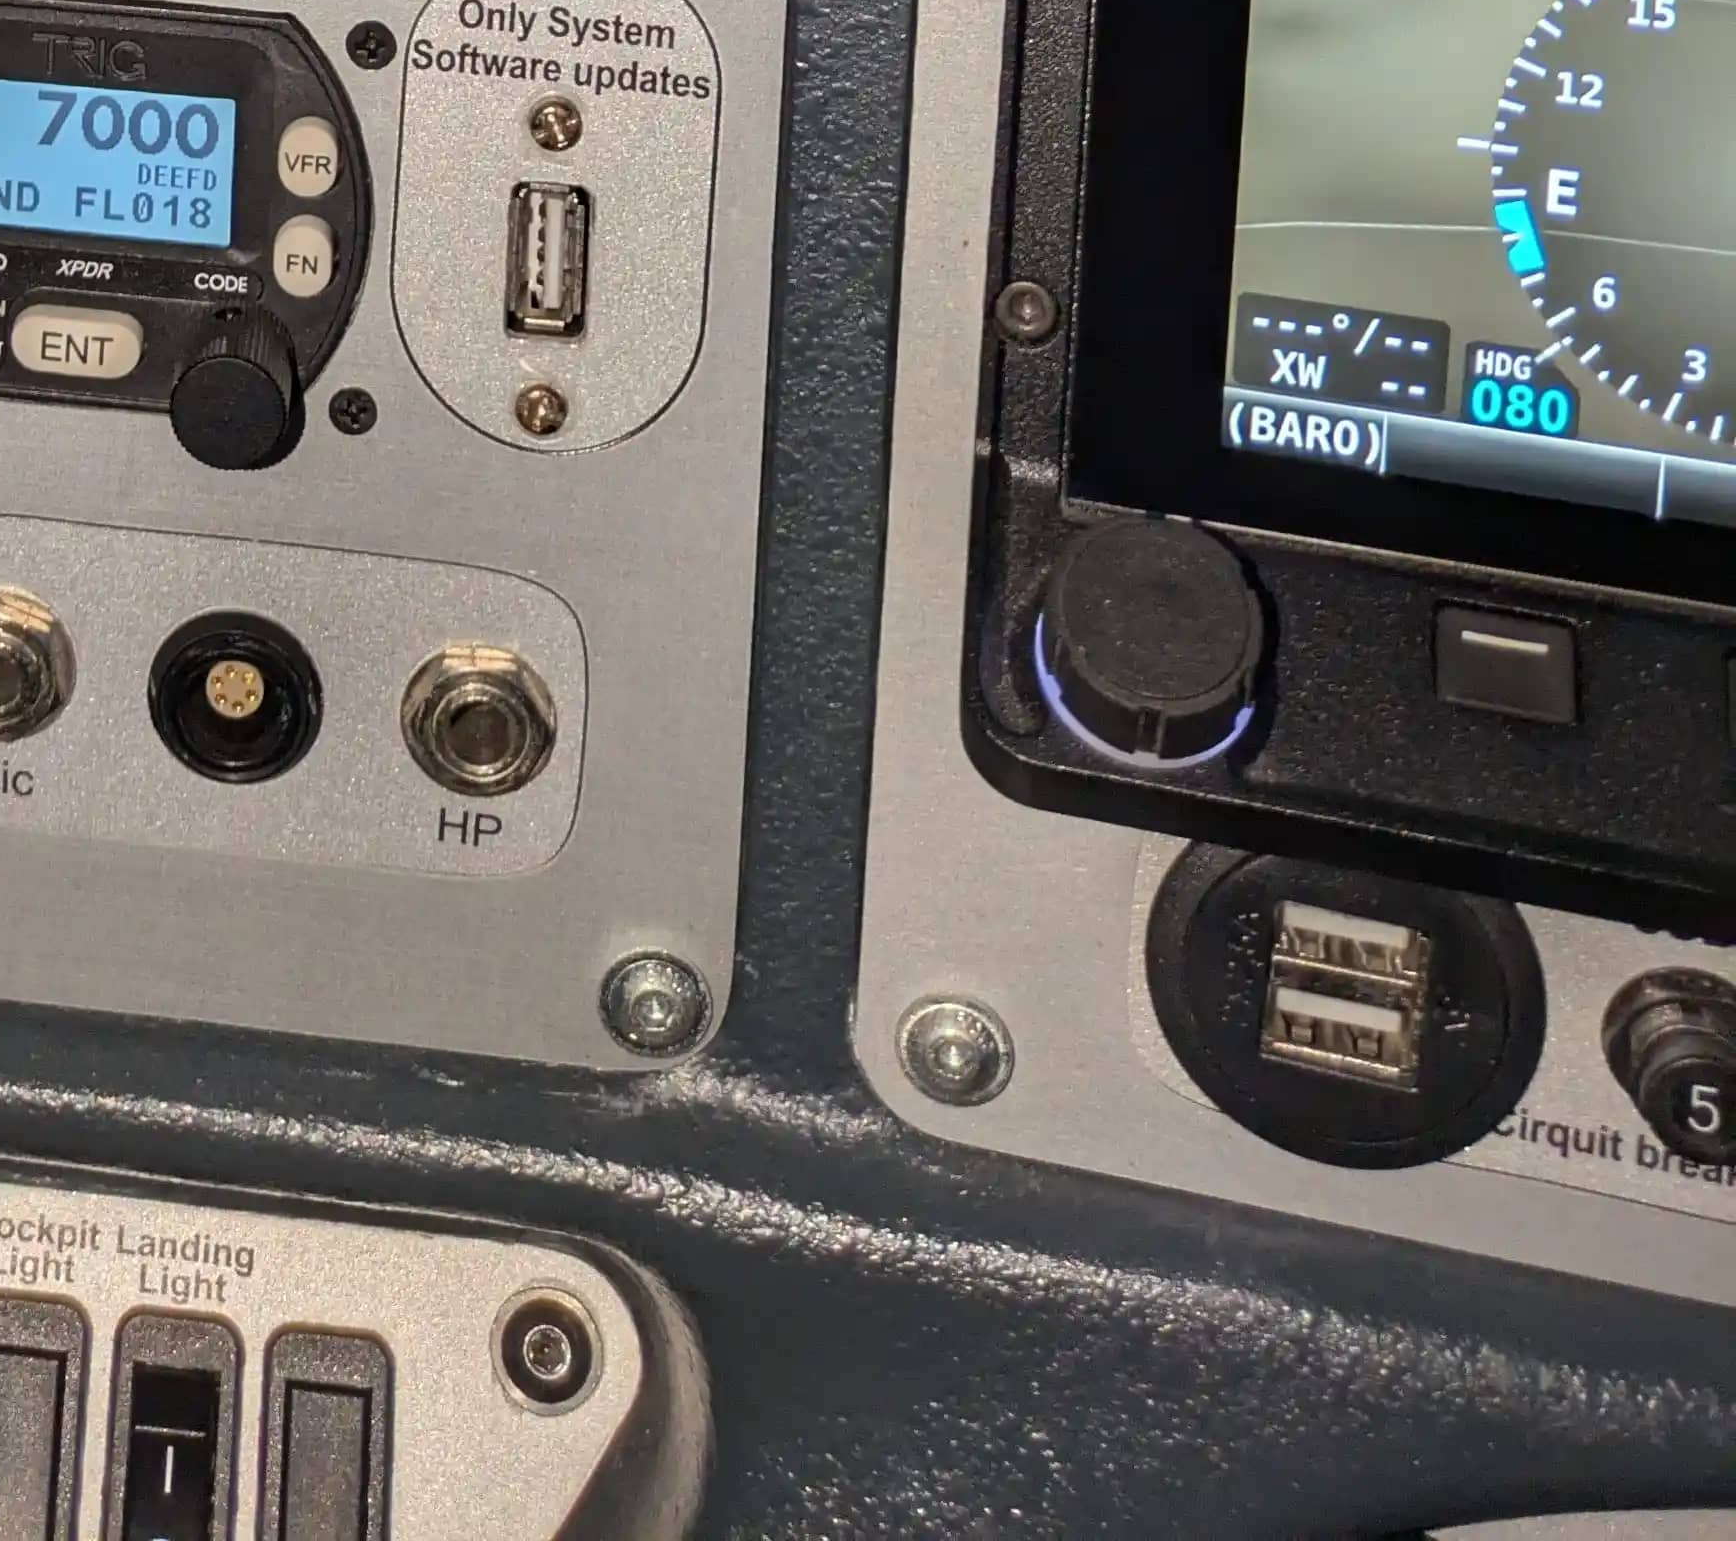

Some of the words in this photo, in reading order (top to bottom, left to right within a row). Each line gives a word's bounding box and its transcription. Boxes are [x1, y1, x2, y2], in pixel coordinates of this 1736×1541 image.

[547, 5, 676, 50] System
[32, 32, 146, 82] TRIG
[411, 39, 562, 82] Software
[573, 59, 711, 100] updates
[1555, 72, 1603, 109] 12
[37, 90, 219, 159] 7000
[138, 162, 217, 191] DEEFD
[285, 153, 331, 175] VFR
[75, 186, 212, 229] FL018
[1546, 169, 1580, 216] E
[56, 258, 114, 281] XPDR
[194, 272, 249, 293] CODE
[286, 253, 319, 275] FN
[40, 331, 115, 366] ENT
[1475, 349, 1533, 381] HDG
[1682, 350, 1706, 381] 3
[1270, 349, 1326, 391] XW
[1471, 380, 1569, 432] 080
[1228, 402, 1382, 466] (BARO)
[438, 809, 503, 847] HP
[1687, 1084, 1721, 1134] 5
[117, 1225, 255, 1277] Landing
[139, 1268, 228, 1304] Light
